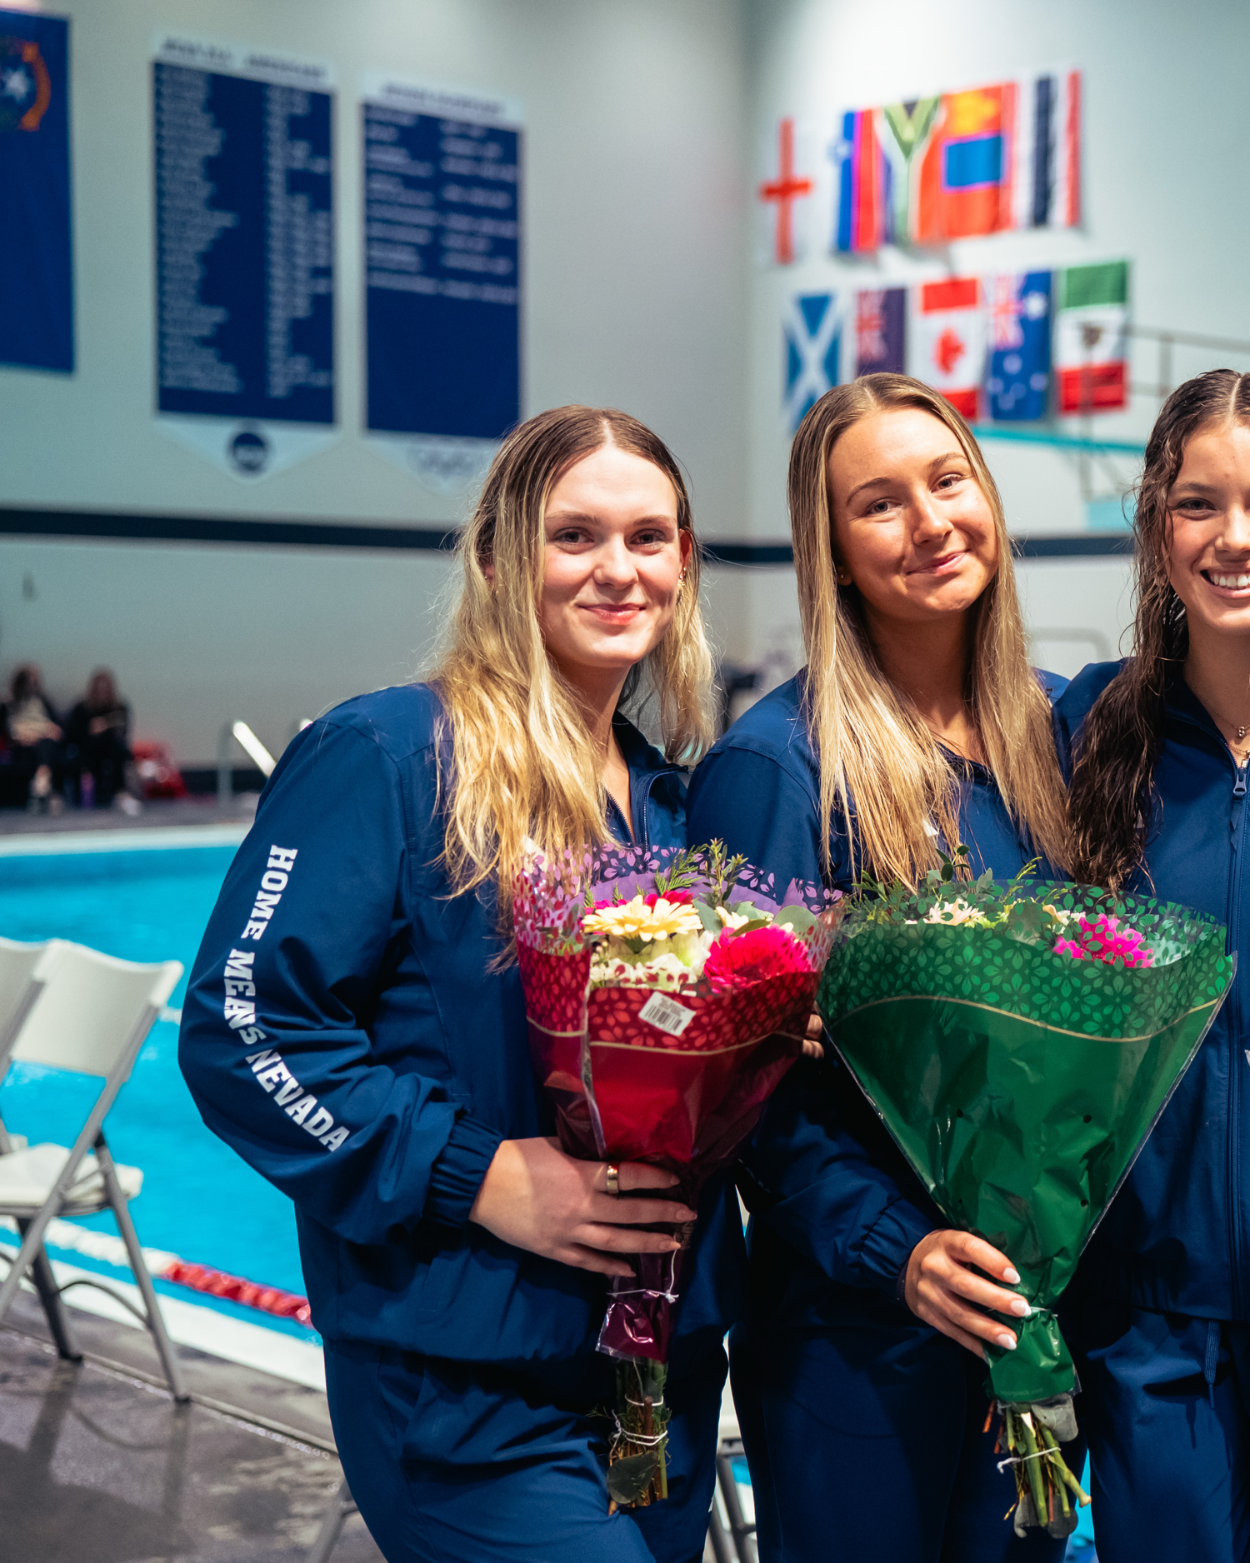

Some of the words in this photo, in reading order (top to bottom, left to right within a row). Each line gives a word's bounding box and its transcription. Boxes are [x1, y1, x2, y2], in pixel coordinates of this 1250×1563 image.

[241, 845, 298, 940] HOME
[223, 948, 267, 1045] MEANS
[245, 1049, 350, 1152] NEVADA
